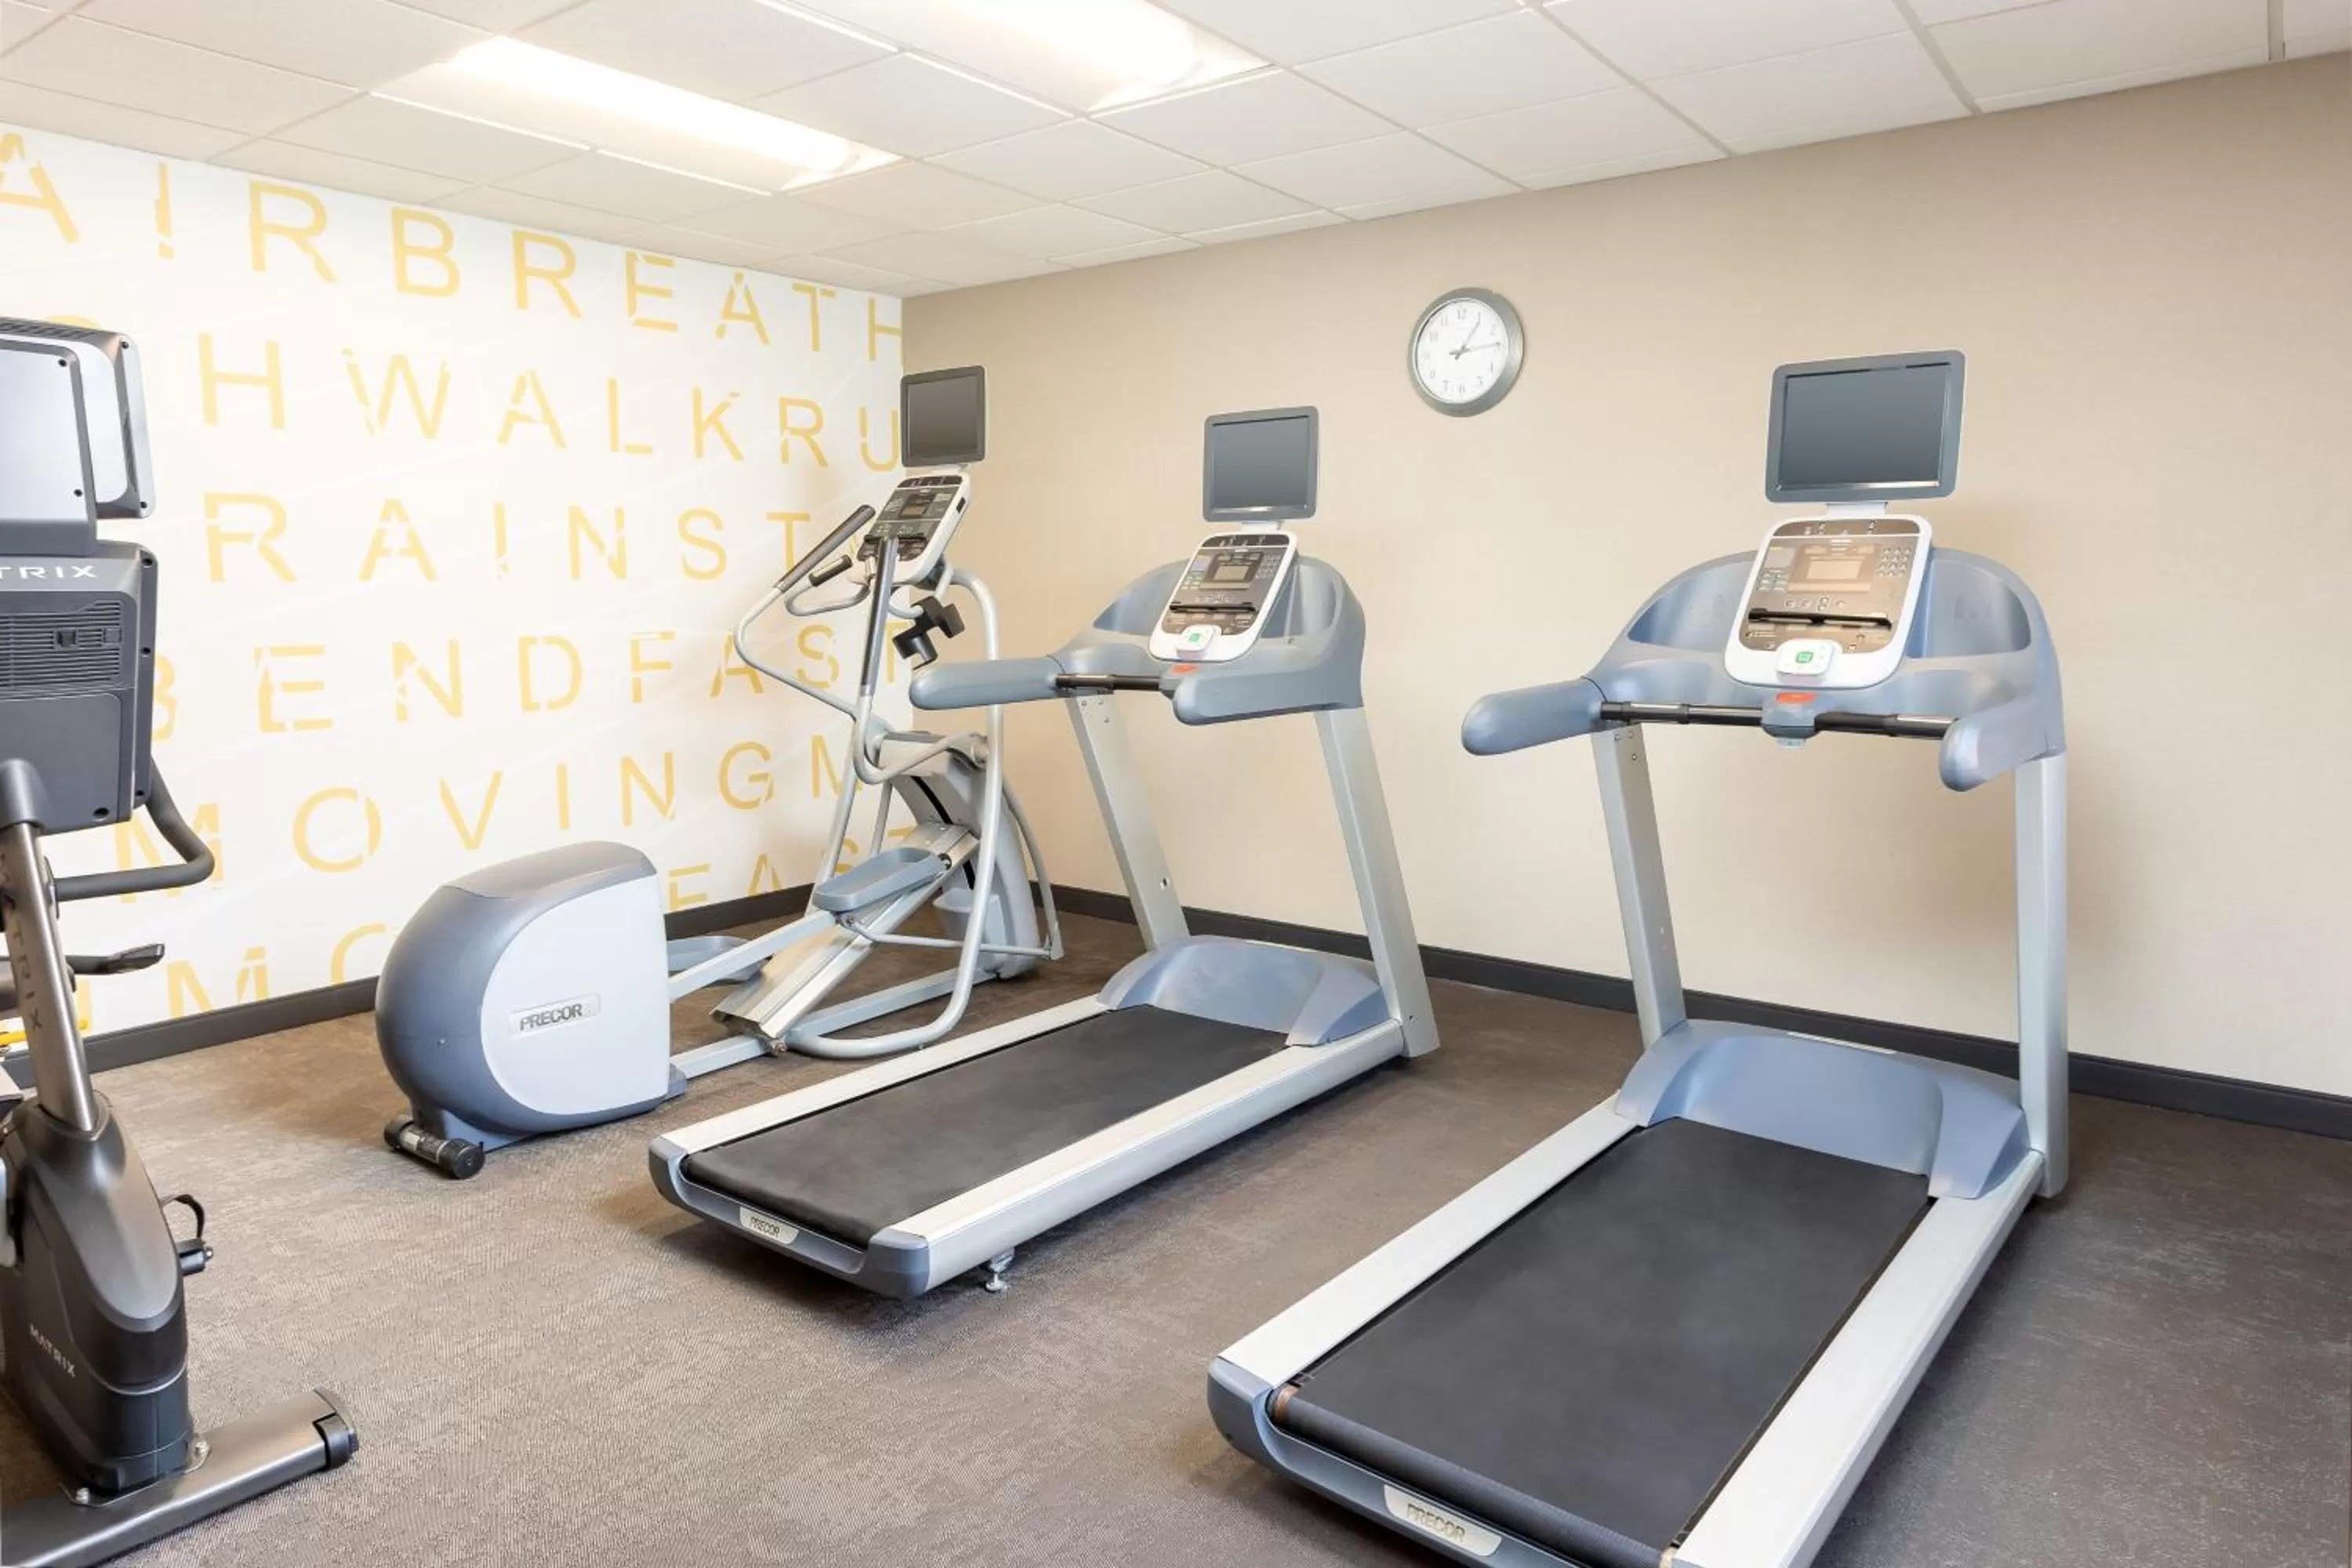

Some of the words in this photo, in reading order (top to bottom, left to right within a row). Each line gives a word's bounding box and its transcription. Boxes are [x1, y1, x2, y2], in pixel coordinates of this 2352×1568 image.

[49, 315, 899, 471] HWALKRU
[201, 491, 876, 583] RAINST
[520, 1003, 583, 1031] PRECOR
[750, 1216, 780, 1237] PRECOR
[1407, 1503, 1465, 1543] PRECOR
